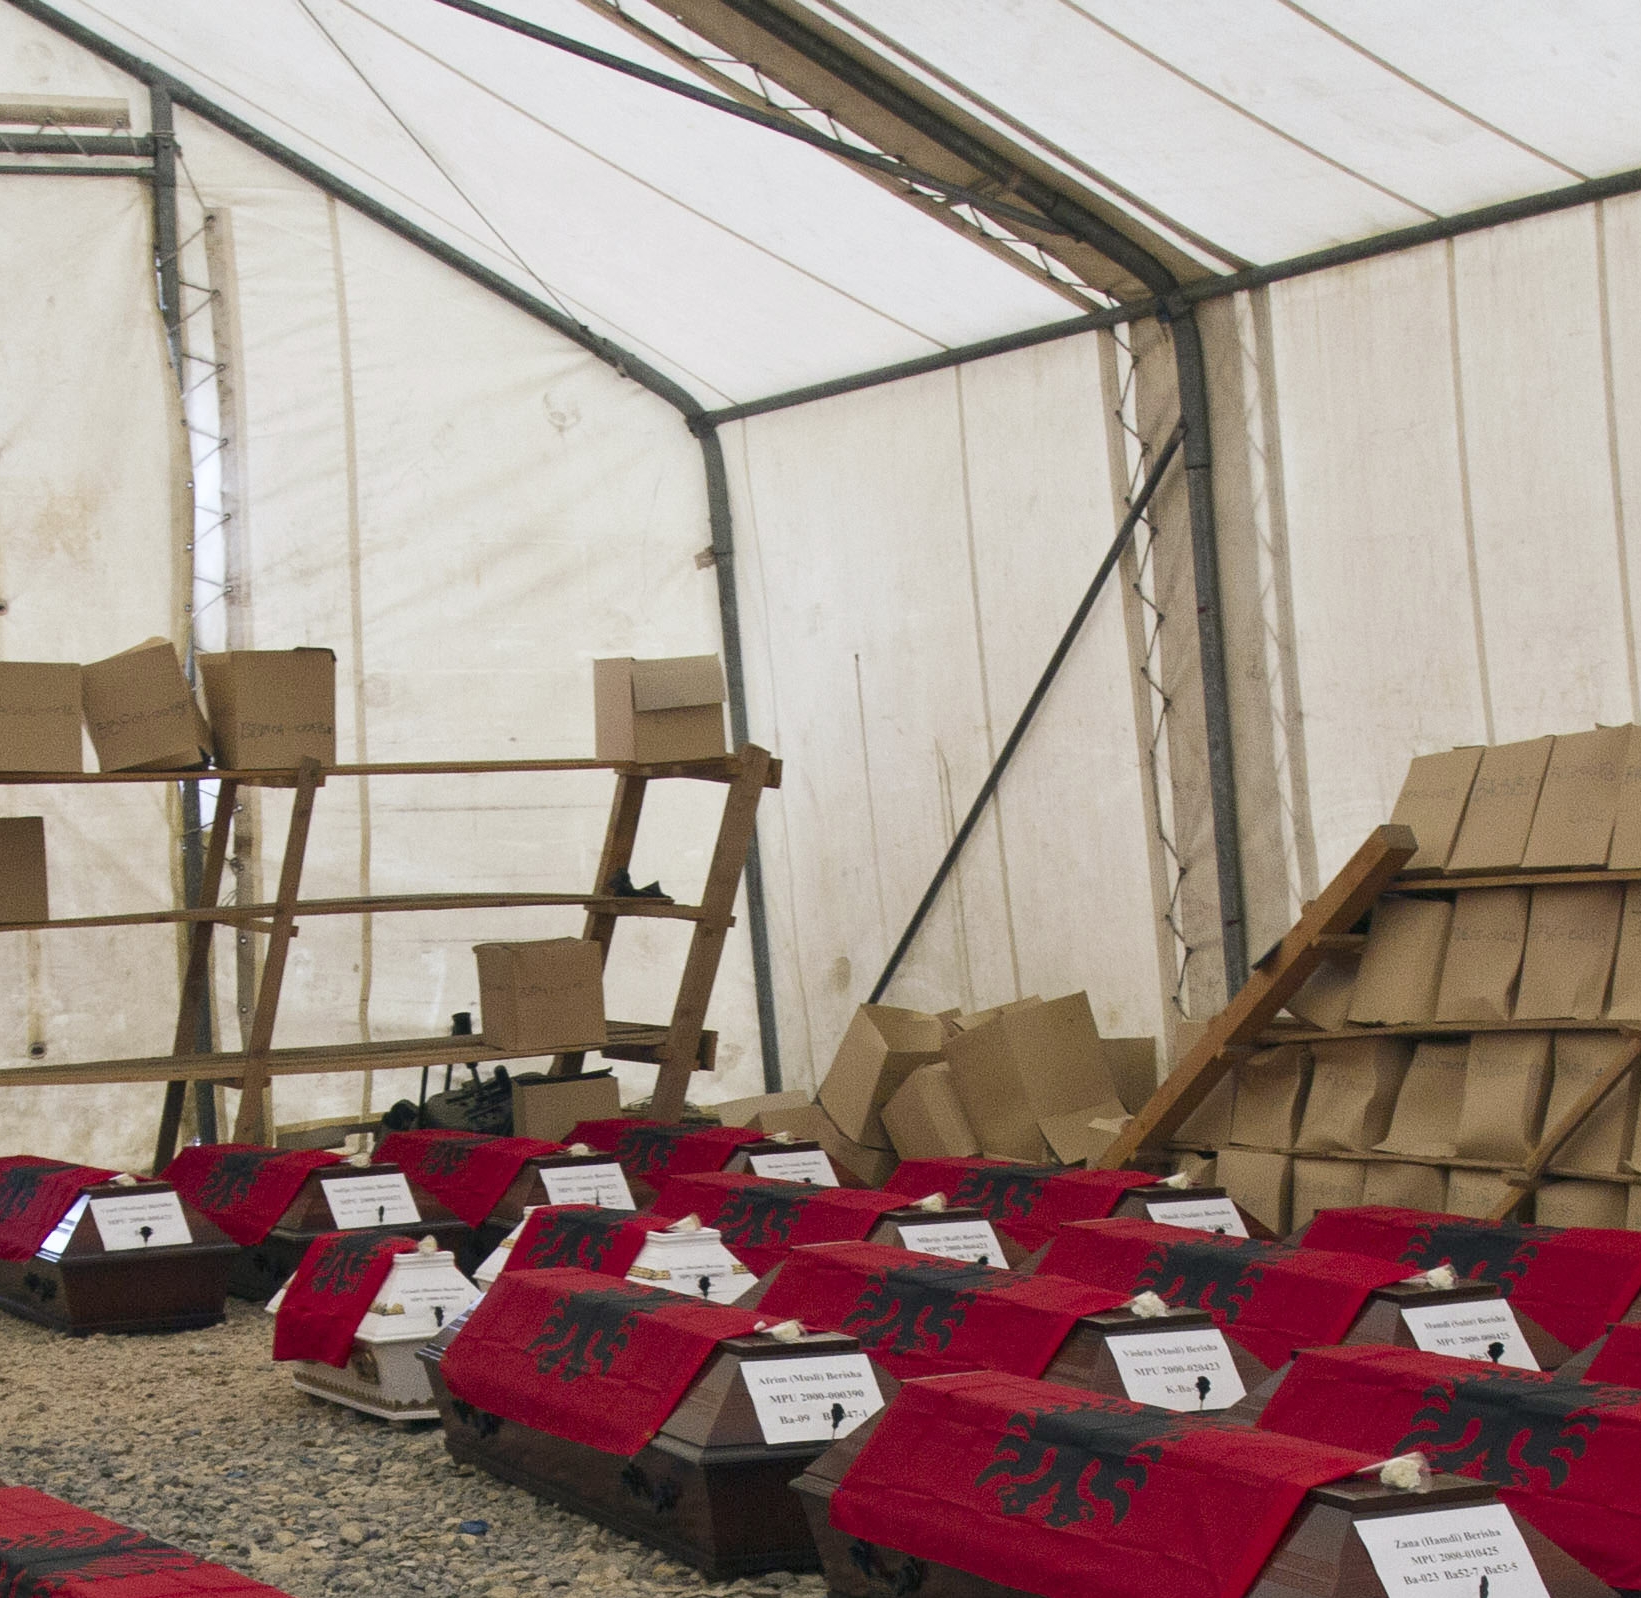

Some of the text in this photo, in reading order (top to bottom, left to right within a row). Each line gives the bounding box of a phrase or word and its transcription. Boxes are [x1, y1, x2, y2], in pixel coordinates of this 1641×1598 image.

[759, 1375, 788, 1386] Afrim
[826, 1369, 863, 1380] Berisha
[1134, 1368, 1159, 1377] MPU
[769, 1393, 797, 1404] MPU
[1394, 1527, 1502, 1550] Zana (Hamdi) Berisha
[1411, 1553, 1438, 1567] MPU
